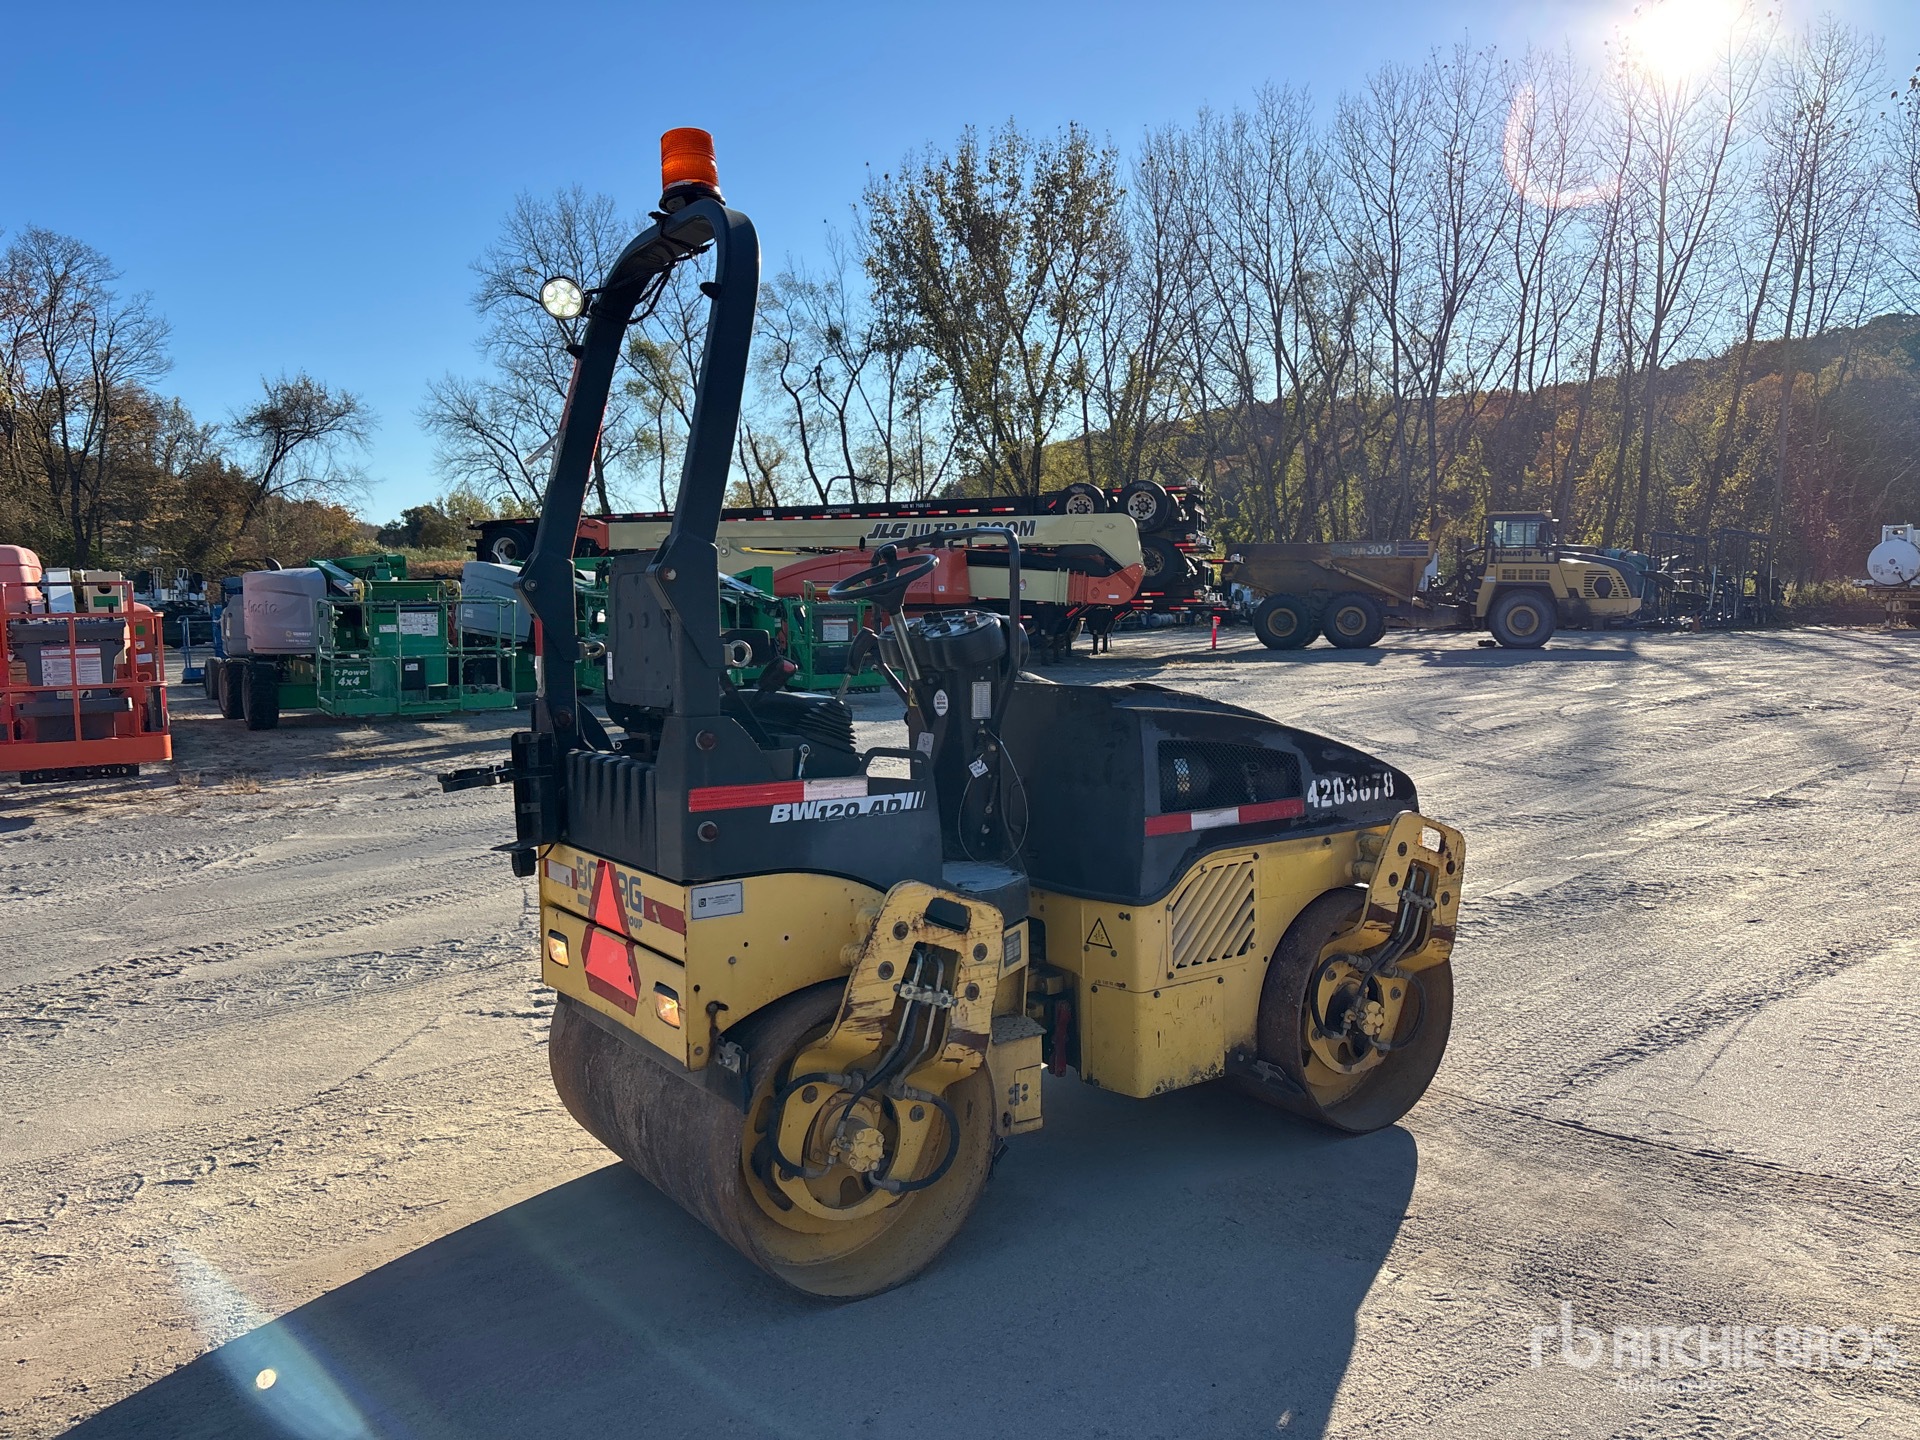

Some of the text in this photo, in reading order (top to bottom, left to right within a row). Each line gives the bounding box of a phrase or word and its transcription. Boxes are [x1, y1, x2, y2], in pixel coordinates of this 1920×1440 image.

[866, 522, 909, 539] JLG
[338, 676, 360, 686] 4x4
[1307, 771, 1394, 808] 4203678
[576, 856, 643, 914] BAG
